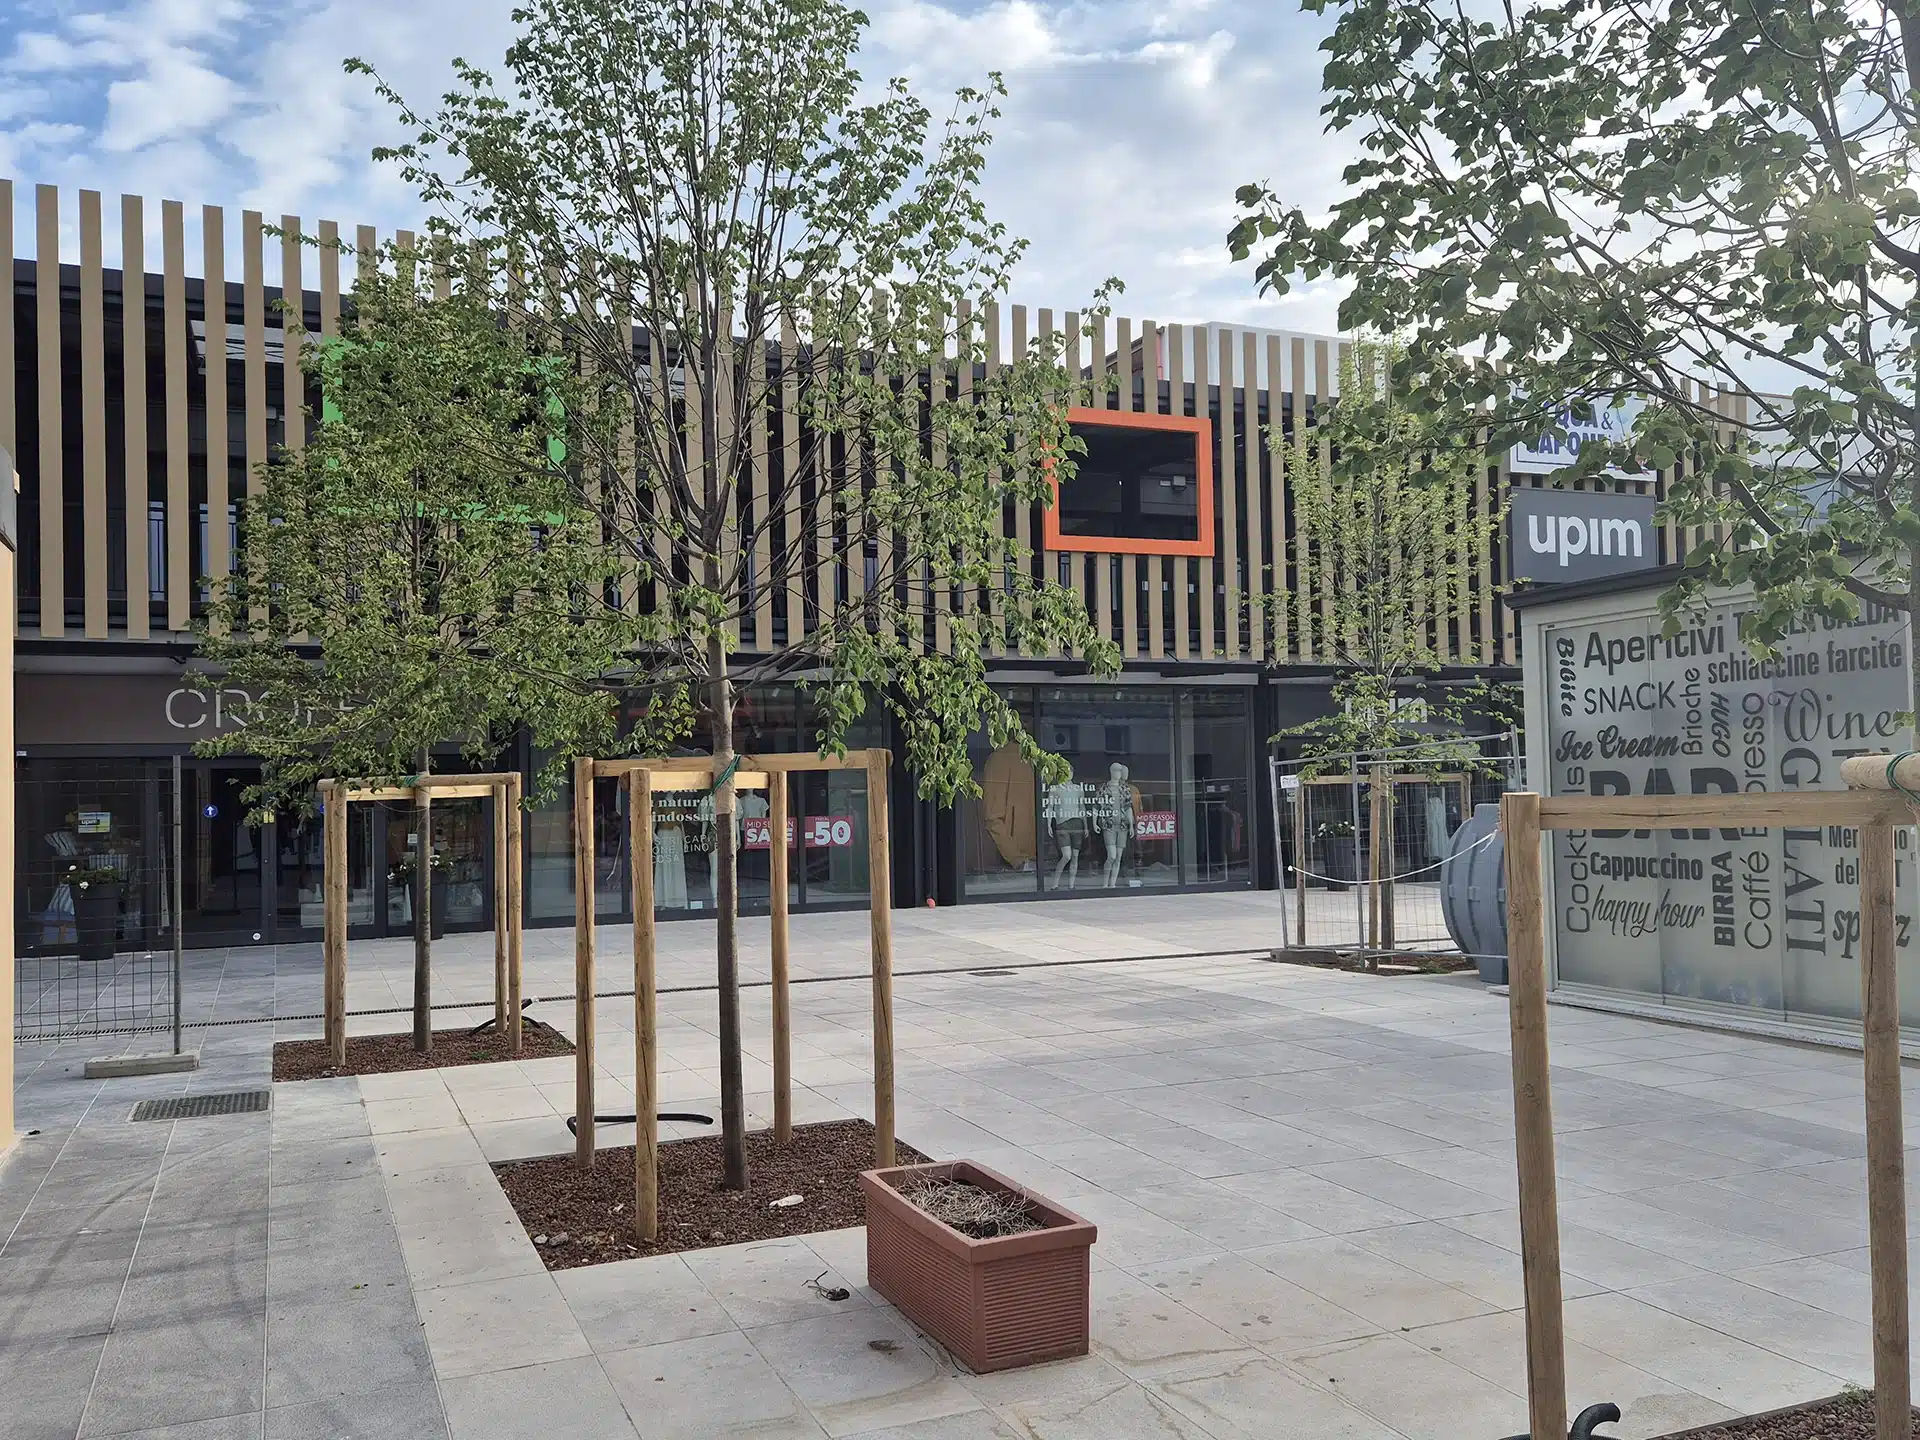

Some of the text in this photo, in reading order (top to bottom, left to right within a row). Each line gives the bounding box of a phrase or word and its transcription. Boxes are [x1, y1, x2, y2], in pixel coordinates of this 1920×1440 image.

[1601, 411, 1614, 430] &
[1528, 515, 1642, 567] upim
[1583, 614, 1725, 676] Aperitivi
[1707, 636, 1903, 684] schiaccine farcite
[1556, 636, 1577, 717] Bibite
[1583, 680, 1677, 715] SNACK
[1679, 667, 1704, 756] Brioche
[1768, 688, 1899, 742] Wine
[1555, 724, 1680, 763] Ice Cream
[746, 820, 794, 829] MID SEN
[746, 827, 794, 843] SAE
[1137, 820, 1176, 834] SALE
[1149, 813, 1176, 821] SEASON
[1562, 766, 1591, 933] Cocktls
[1590, 851, 1704, 882] Cappuccino
[1780, 748, 1827, 957] GLATI
[1592, 884, 1705, 939] happy hour
[1711, 851, 1737, 947] BIRRA
[1739, 851, 1772, 950] Caffé
[1832, 909, 1911, 959] spz
